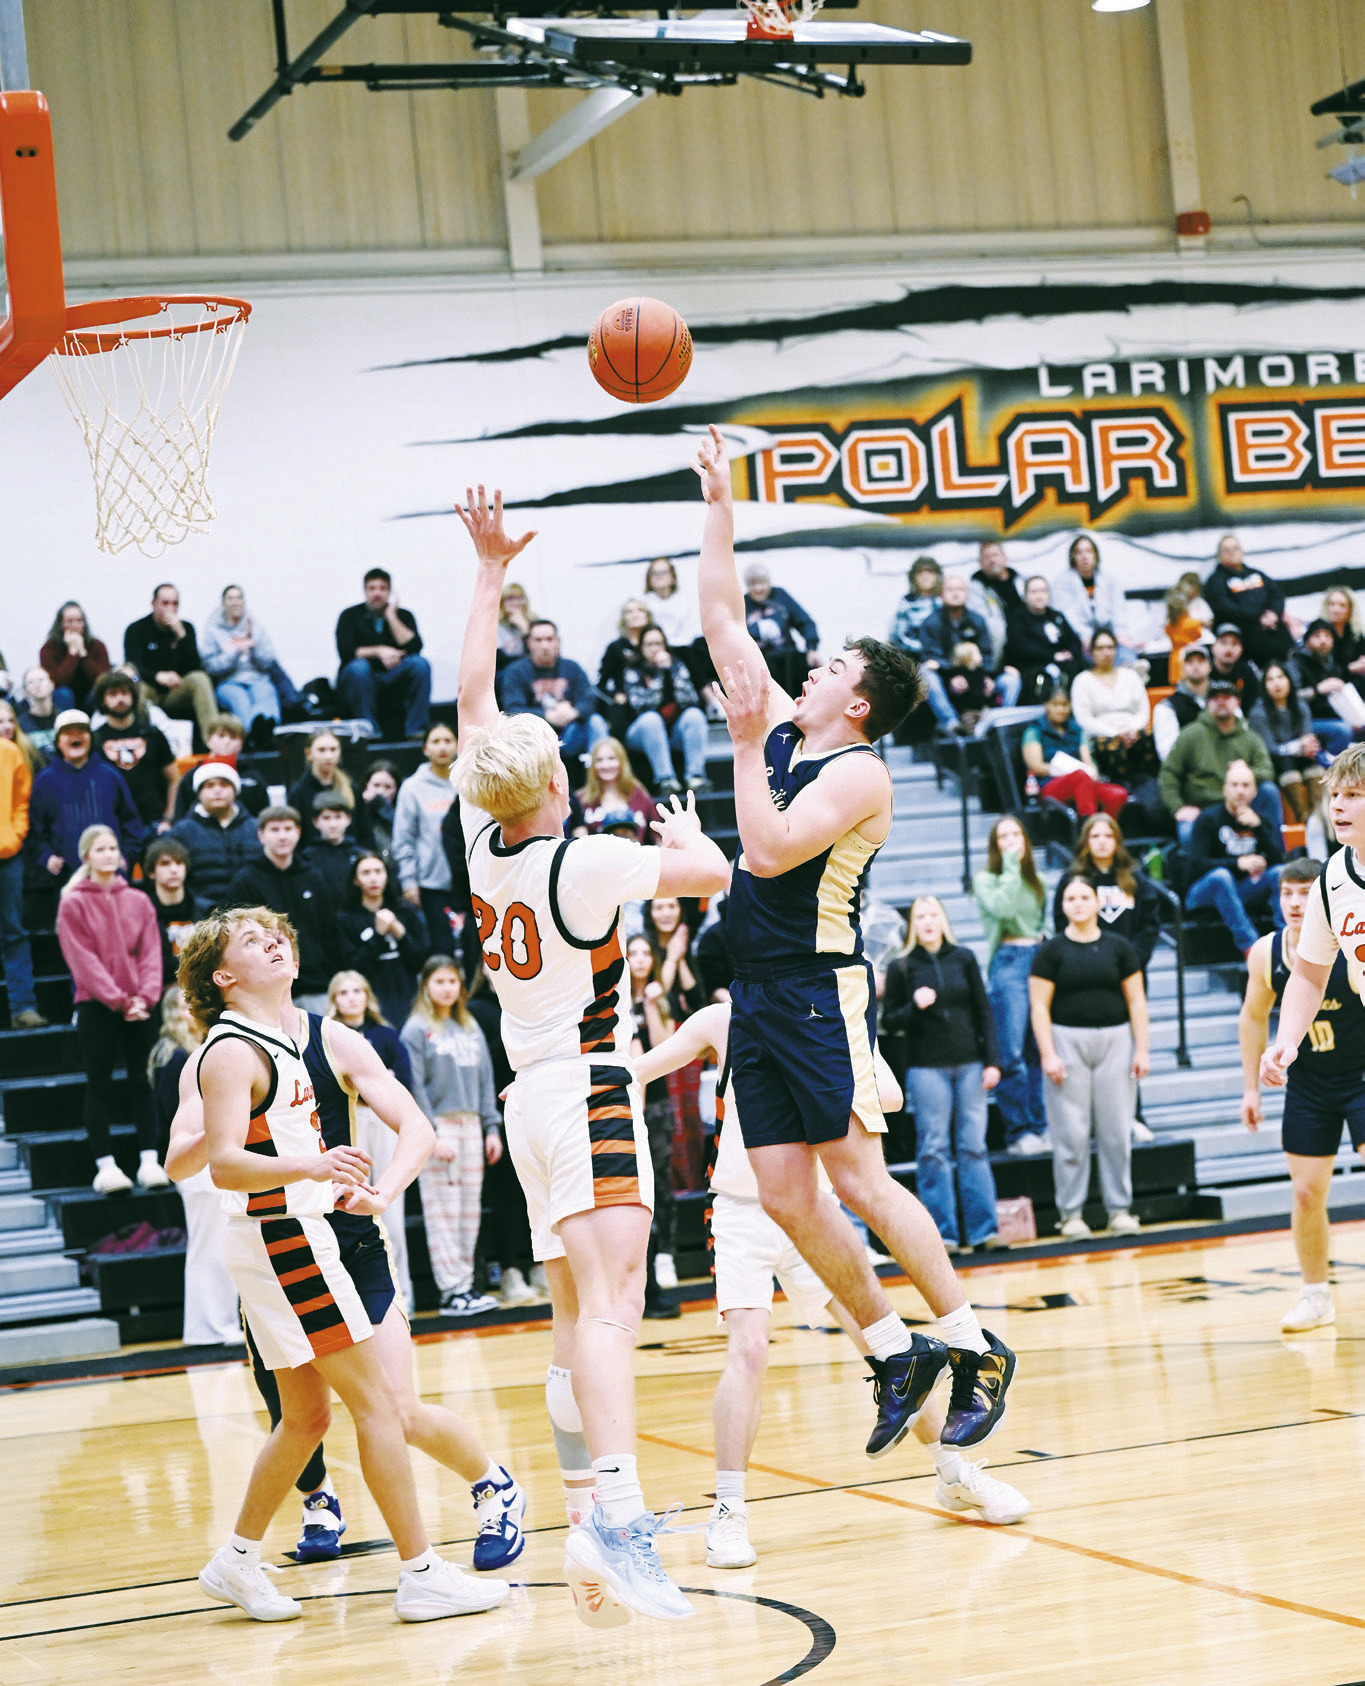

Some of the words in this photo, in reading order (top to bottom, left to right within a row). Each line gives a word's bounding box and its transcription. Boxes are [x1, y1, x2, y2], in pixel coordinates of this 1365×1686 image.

[755, 412, 1178, 509] POLAR
[471, 892, 543, 981] 20
[1308, 1020, 1336, 1053] 10
